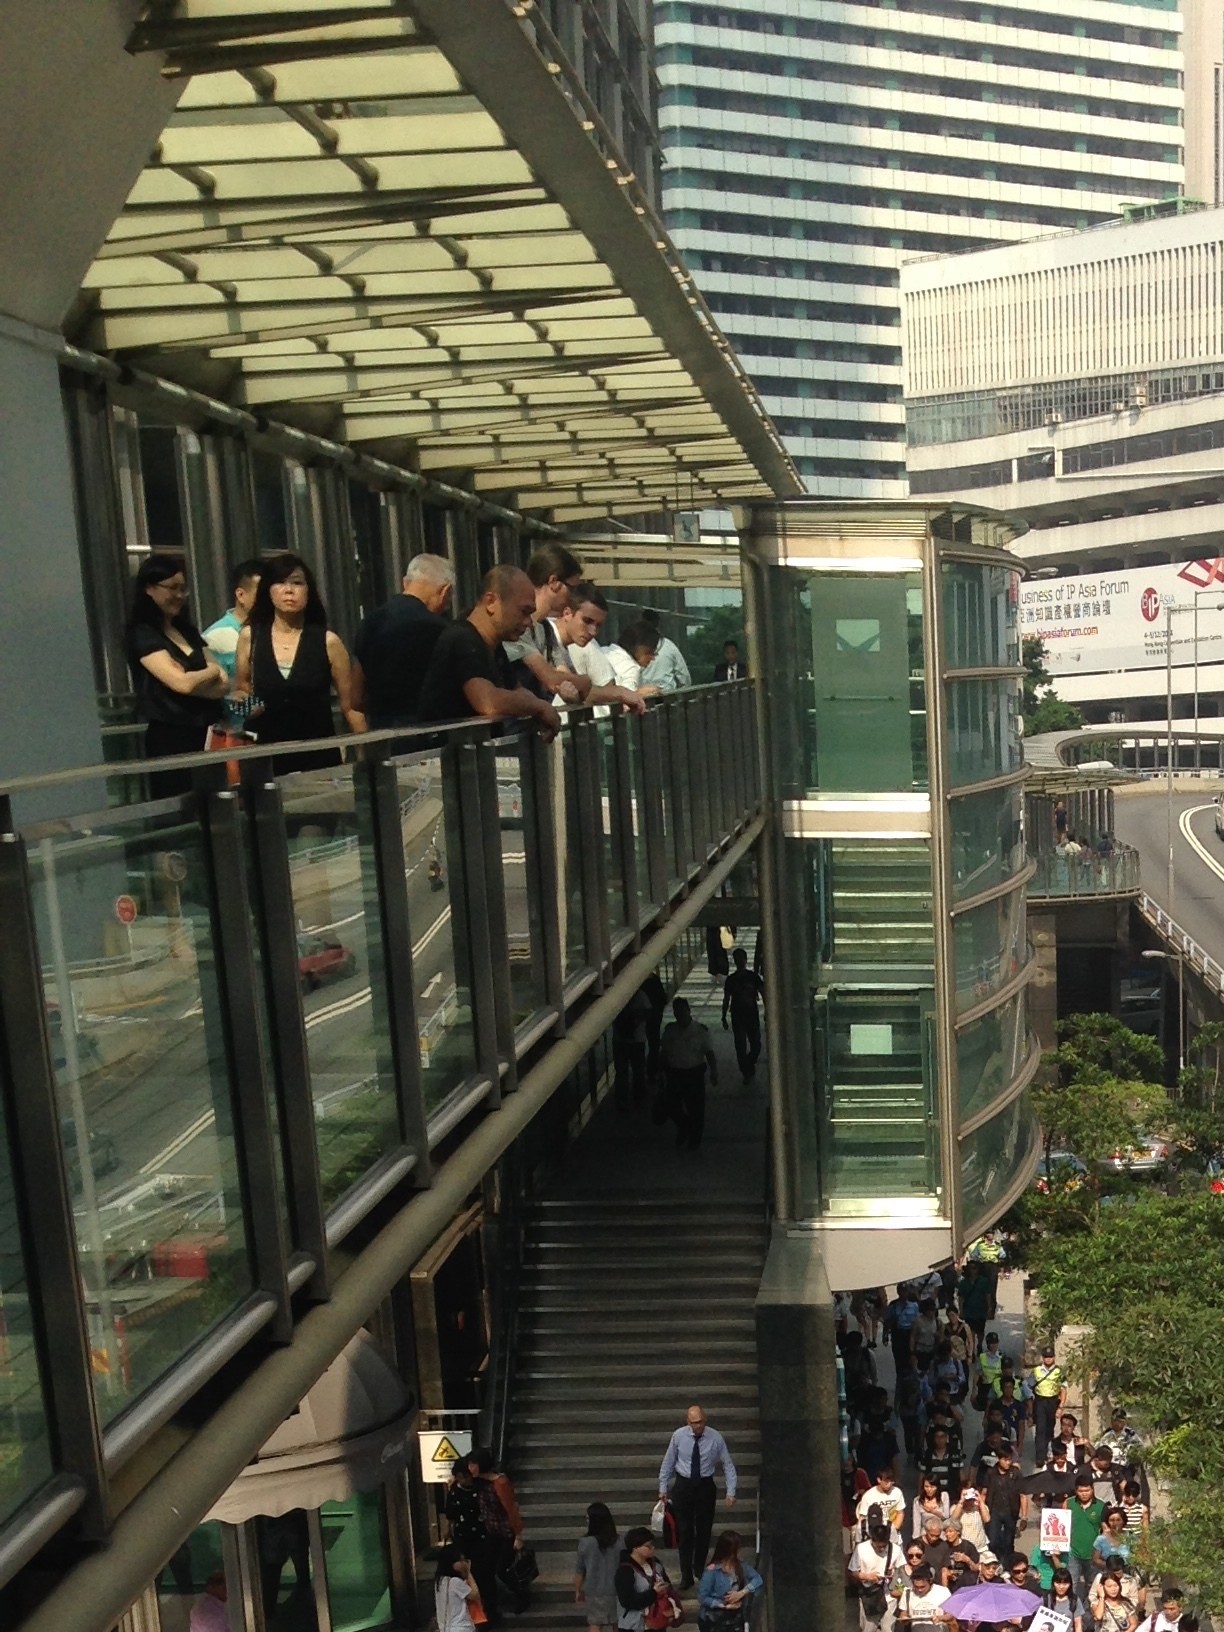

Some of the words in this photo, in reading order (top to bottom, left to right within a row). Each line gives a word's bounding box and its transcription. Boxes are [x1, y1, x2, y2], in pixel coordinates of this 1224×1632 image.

[1021, 588, 1054, 605] usiness
[1055, 584, 1065, 601] of
[1066, 584, 1077, 600] IP
[1078, 583, 1098, 598] Asia
[1100, 580, 1130, 597] Forum
